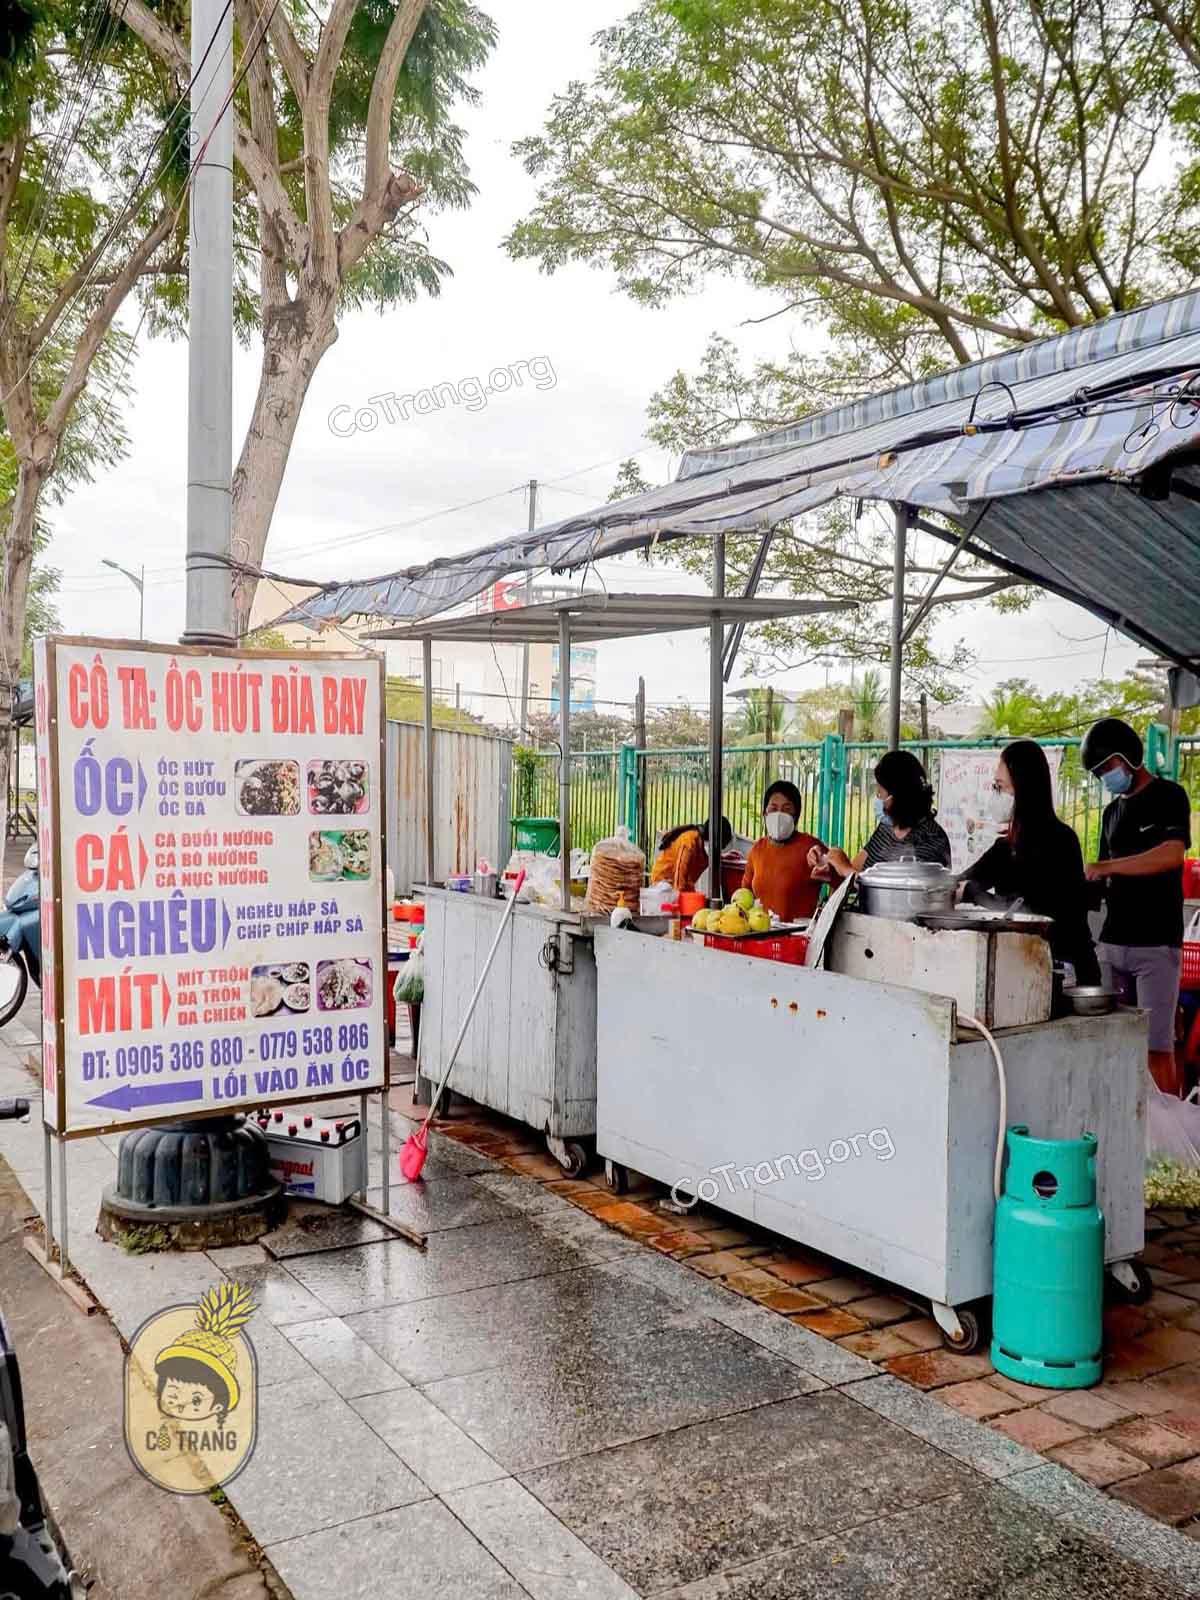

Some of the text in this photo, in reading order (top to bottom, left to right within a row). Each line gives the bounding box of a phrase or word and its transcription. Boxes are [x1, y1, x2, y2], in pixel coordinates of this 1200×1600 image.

[69, 654, 109, 729] CÔ
[118, 666, 156, 730] TA:
[211, 664, 263, 734] HÚT
[271, 666, 316, 735] ĐĨA
[322, 676, 368, 735] BAY
[74, 738, 133, 816] ỐC
[75, 825, 135, 893] CÁ
[76, 889, 217, 960] NGHÊU
[236, 902, 283, 920] NGHÊU
[237, 922, 271, 940] CHÍP
[276, 920, 309, 938] CHÍP
[77, 965, 158, 1035] MÍT
[82, 1050, 110, 1080] ĐT:
[116, 1044, 164, 1077] 0905
[170, 1040, 204, 1072] 386
[211, 1036, 243, 1066] 880
[260, 1030, 297, 1061] 0779
[303, 1026, 333, 1056] 538
[338, 1022, 369, 1052] 886
[212, 1053, 370, 1099] LỐI VÀO ĂN ỐC
